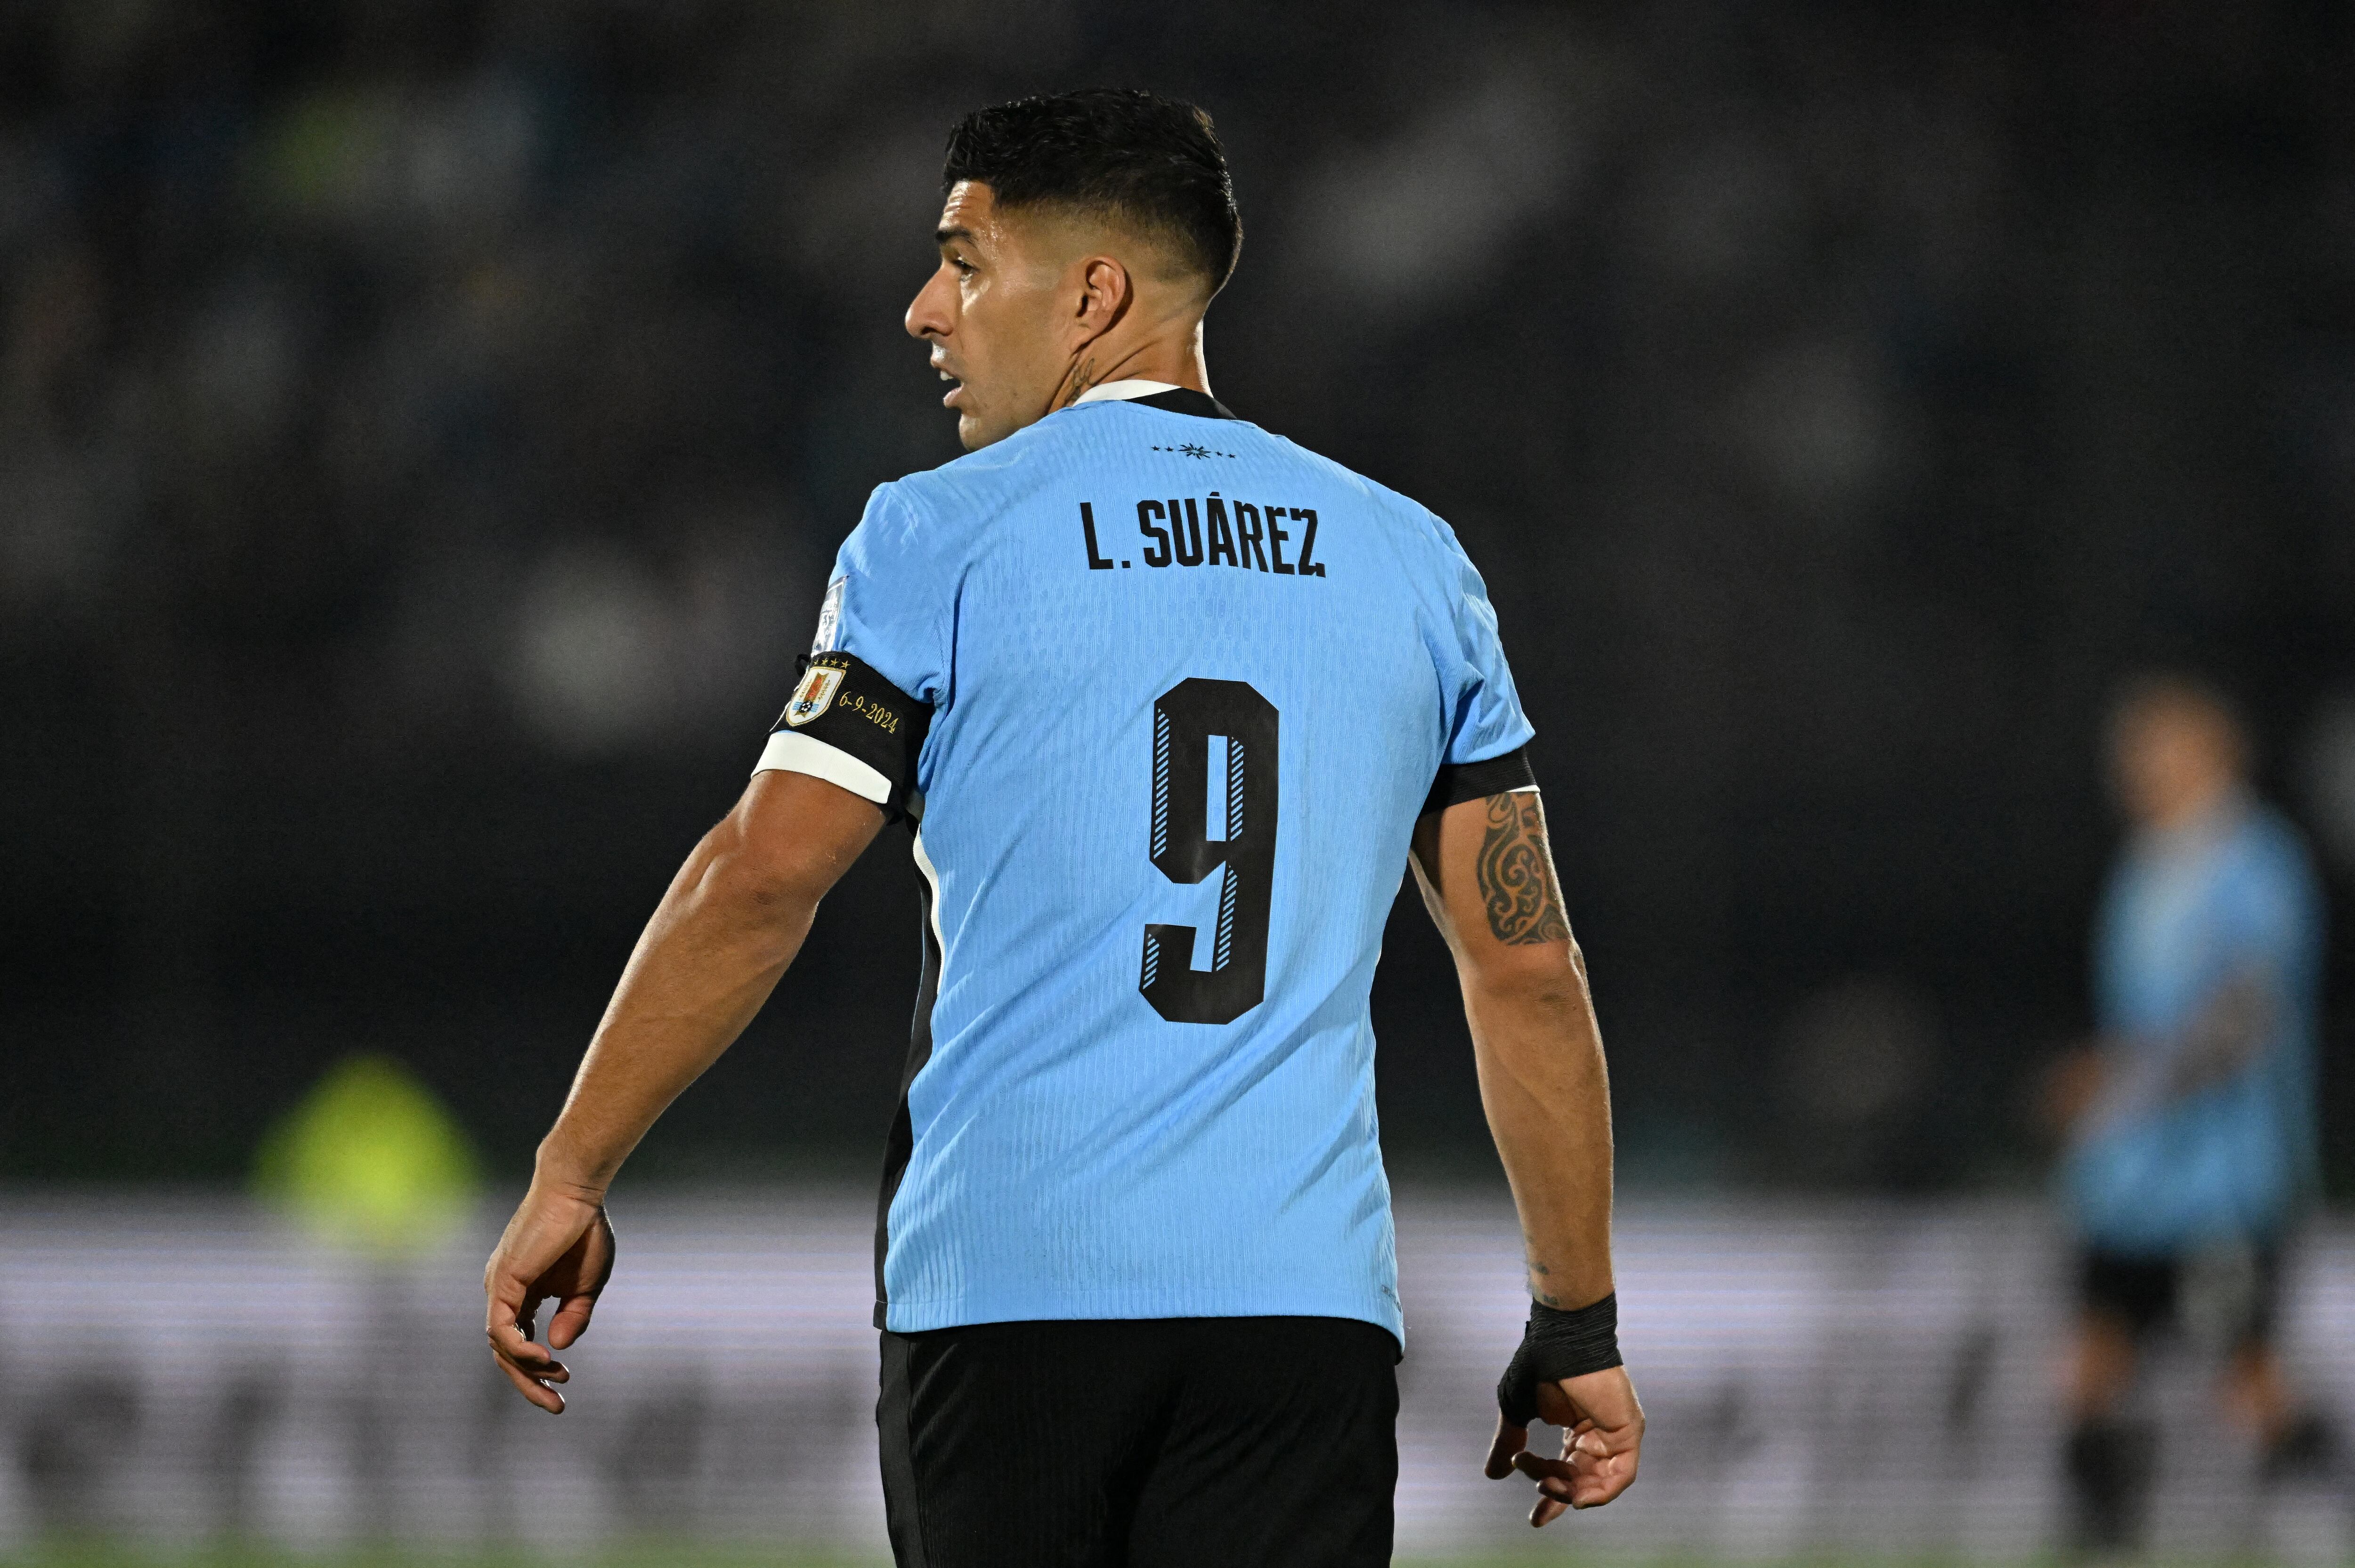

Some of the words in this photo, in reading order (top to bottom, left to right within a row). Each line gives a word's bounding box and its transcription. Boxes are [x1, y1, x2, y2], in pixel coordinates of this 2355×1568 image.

[1080, 502, 1131, 570] L.
[1137, 492, 1326, 578] SUÁREZ
[839, 691, 899, 734] 6-9-2024
[1139, 677, 1279, 1025] 9
